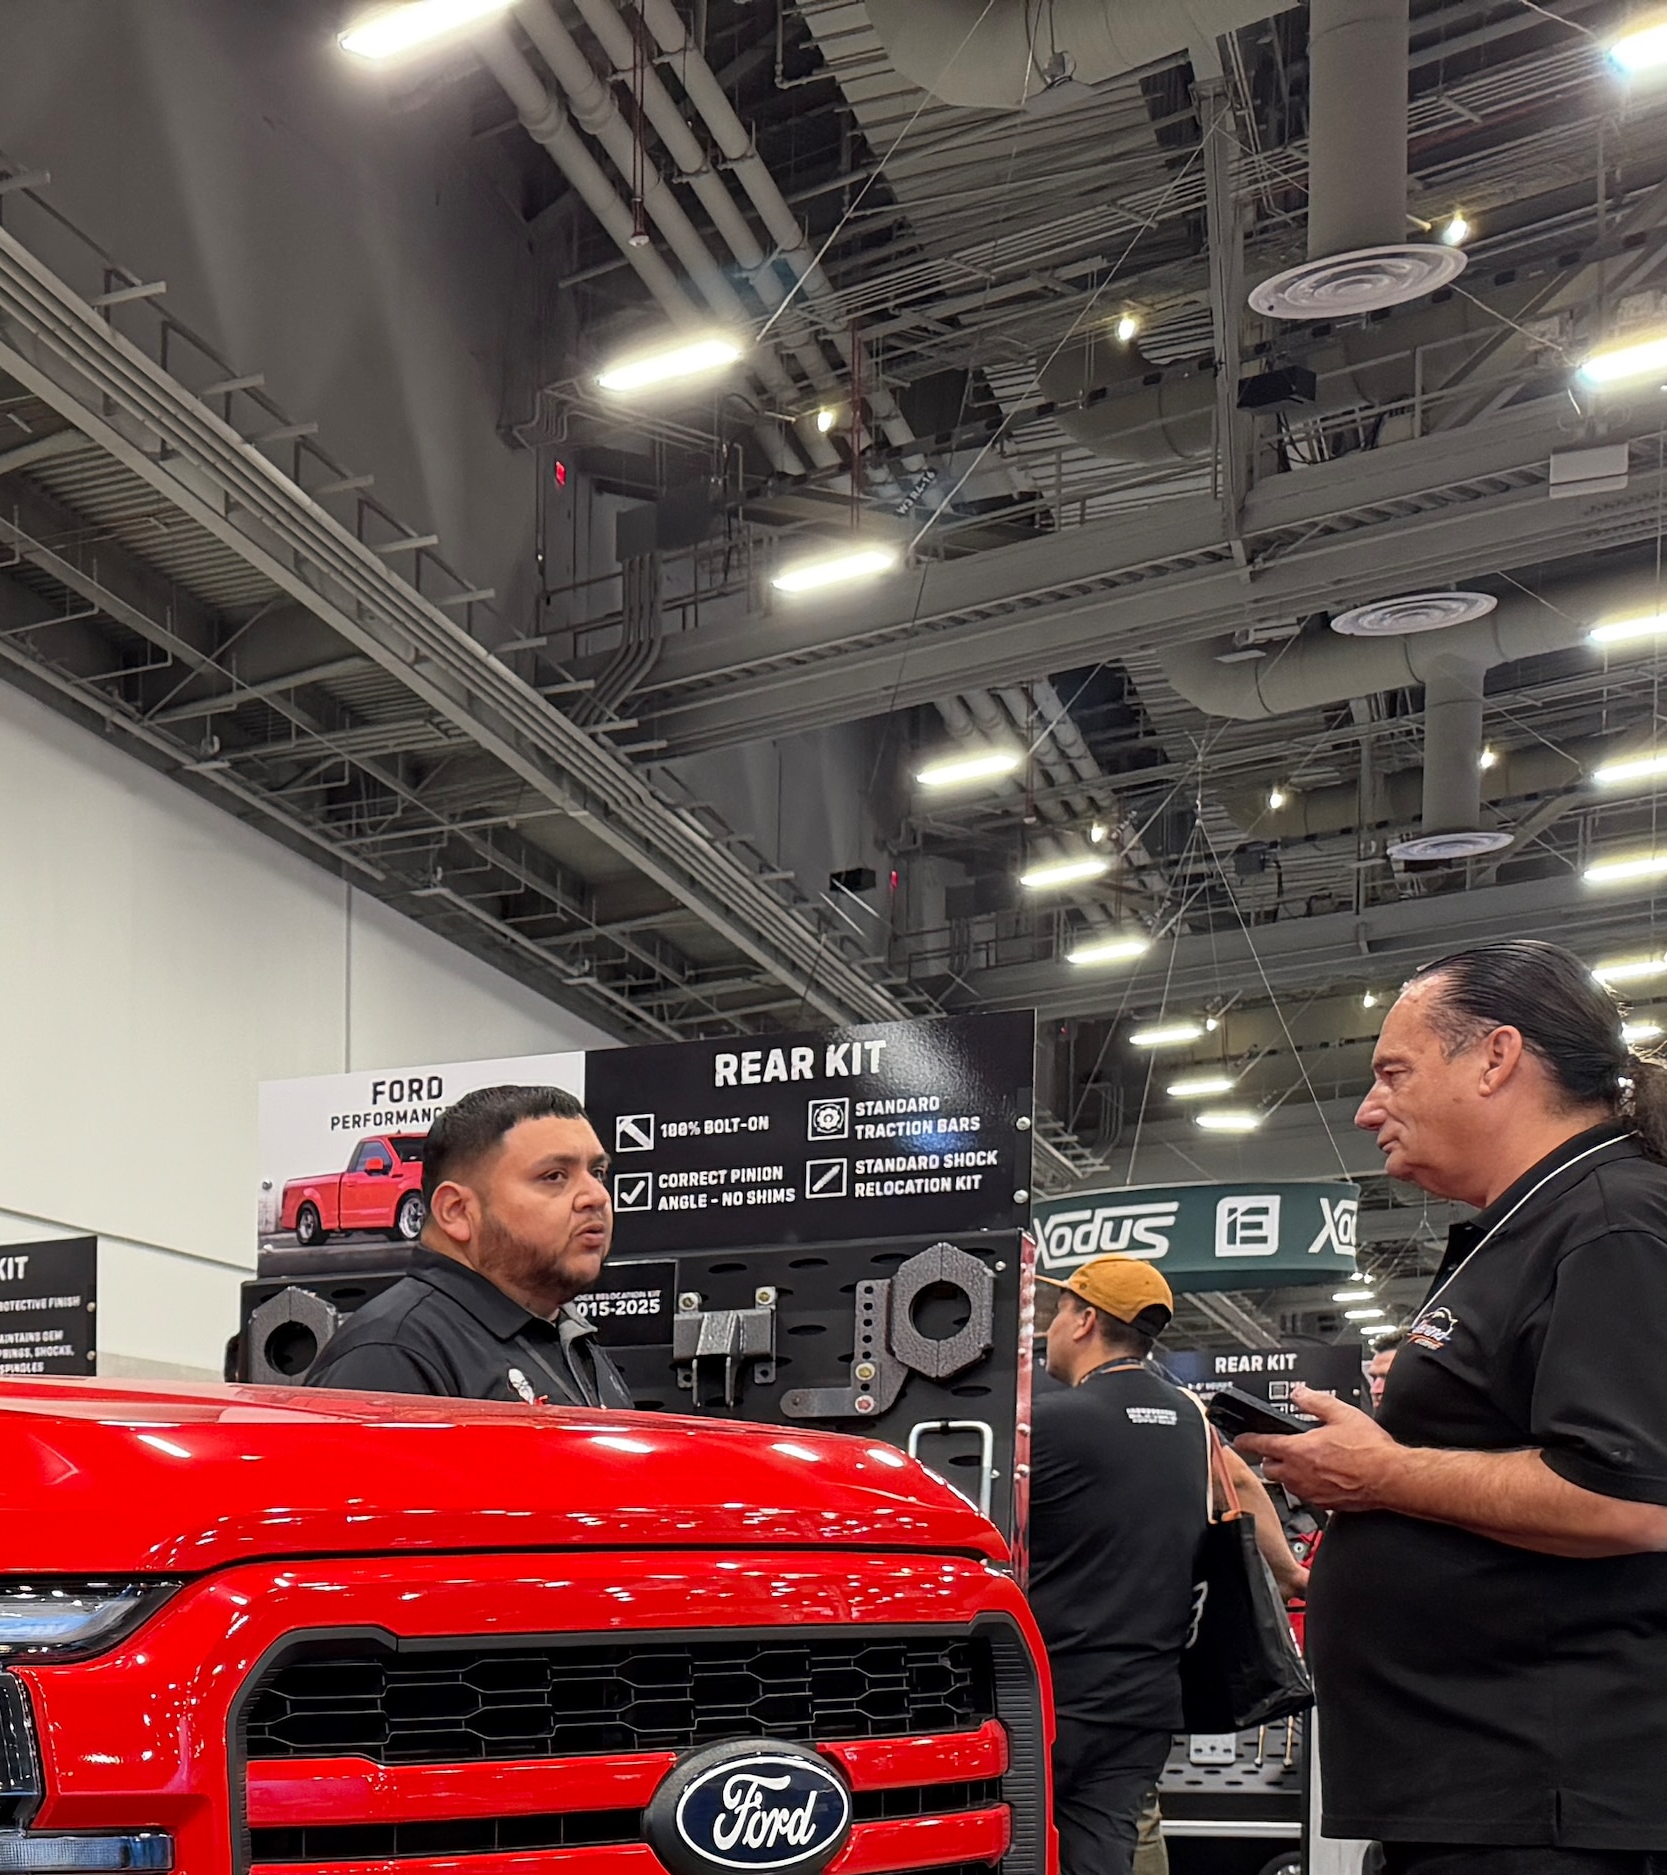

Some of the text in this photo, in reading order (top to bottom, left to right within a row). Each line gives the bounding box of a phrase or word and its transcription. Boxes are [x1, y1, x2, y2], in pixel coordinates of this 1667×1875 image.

[715, 1039, 886, 1088] REAR KIT
[372, 1076, 443, 1105] FORD
[330, 1106, 450, 1131] PERFORMANC
[855, 1096, 939, 1117] STANDARD
[660, 1116, 769, 1138] 100% BOLT-ON
[855, 1116, 980, 1140] TRACTION BARS
[855, 1150, 998, 1175] STANDARD SHOCK
[658, 1166, 783, 1189] CORRECT PINION
[855, 1174, 983, 1198] RELOCATION KIT
[658, 1194, 707, 1211] ANGLE
[722, 1192, 743, 1207] NO
[746, 1188, 795, 1205] SHIMS
[577, 1298, 660, 1317] 015-2025
[1215, 1353, 1297, 1373] REAR KIT
[713, 1773, 818, 1850] Ford
